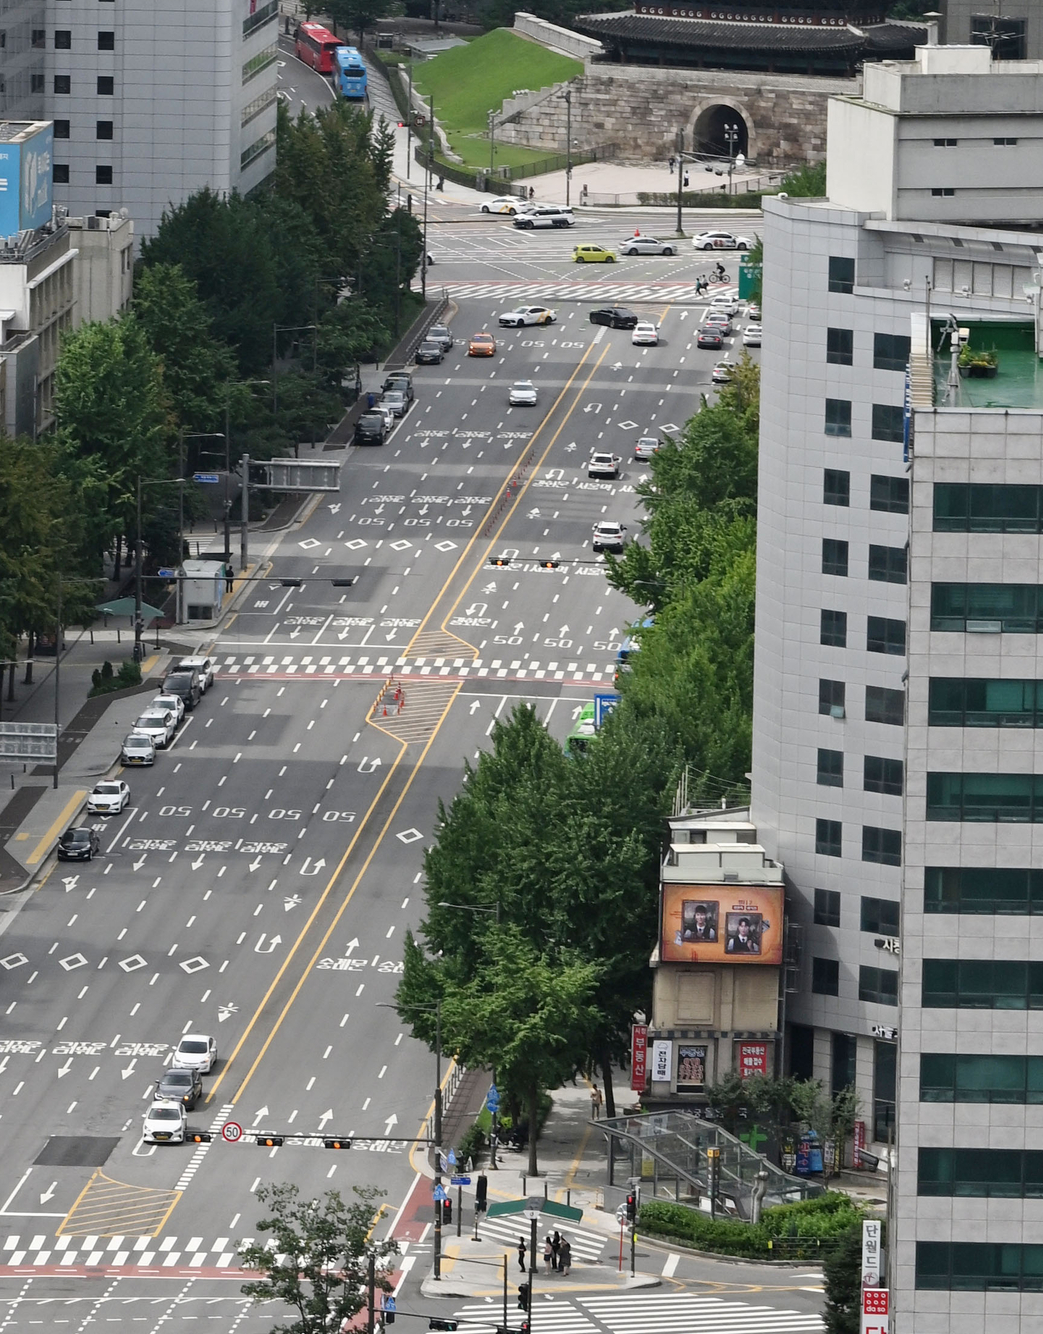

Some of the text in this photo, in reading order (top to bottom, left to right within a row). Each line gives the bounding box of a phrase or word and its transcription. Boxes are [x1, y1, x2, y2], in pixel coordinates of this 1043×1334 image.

[357, 517, 386, 527] 50
[404, 518, 432, 527] 50
[446, 519, 475, 528] 50
[492, 635, 524, 646] 50
[543, 637, 573, 649] 50
[592, 641, 622, 652] 50
[159, 805, 193, 817] 50
[212, 807, 247, 818] 50
[267, 809, 303, 820] 50
[322, 811, 357, 823] 50
[316, 957, 369, 972] 숭례문
[635, 1038, 646, 1077] 부동산
[657, 1050, 668, 1077] 전자담배
[226, 1127, 239, 1138] 50
[864, 1224, 879, 1269] 단월드
